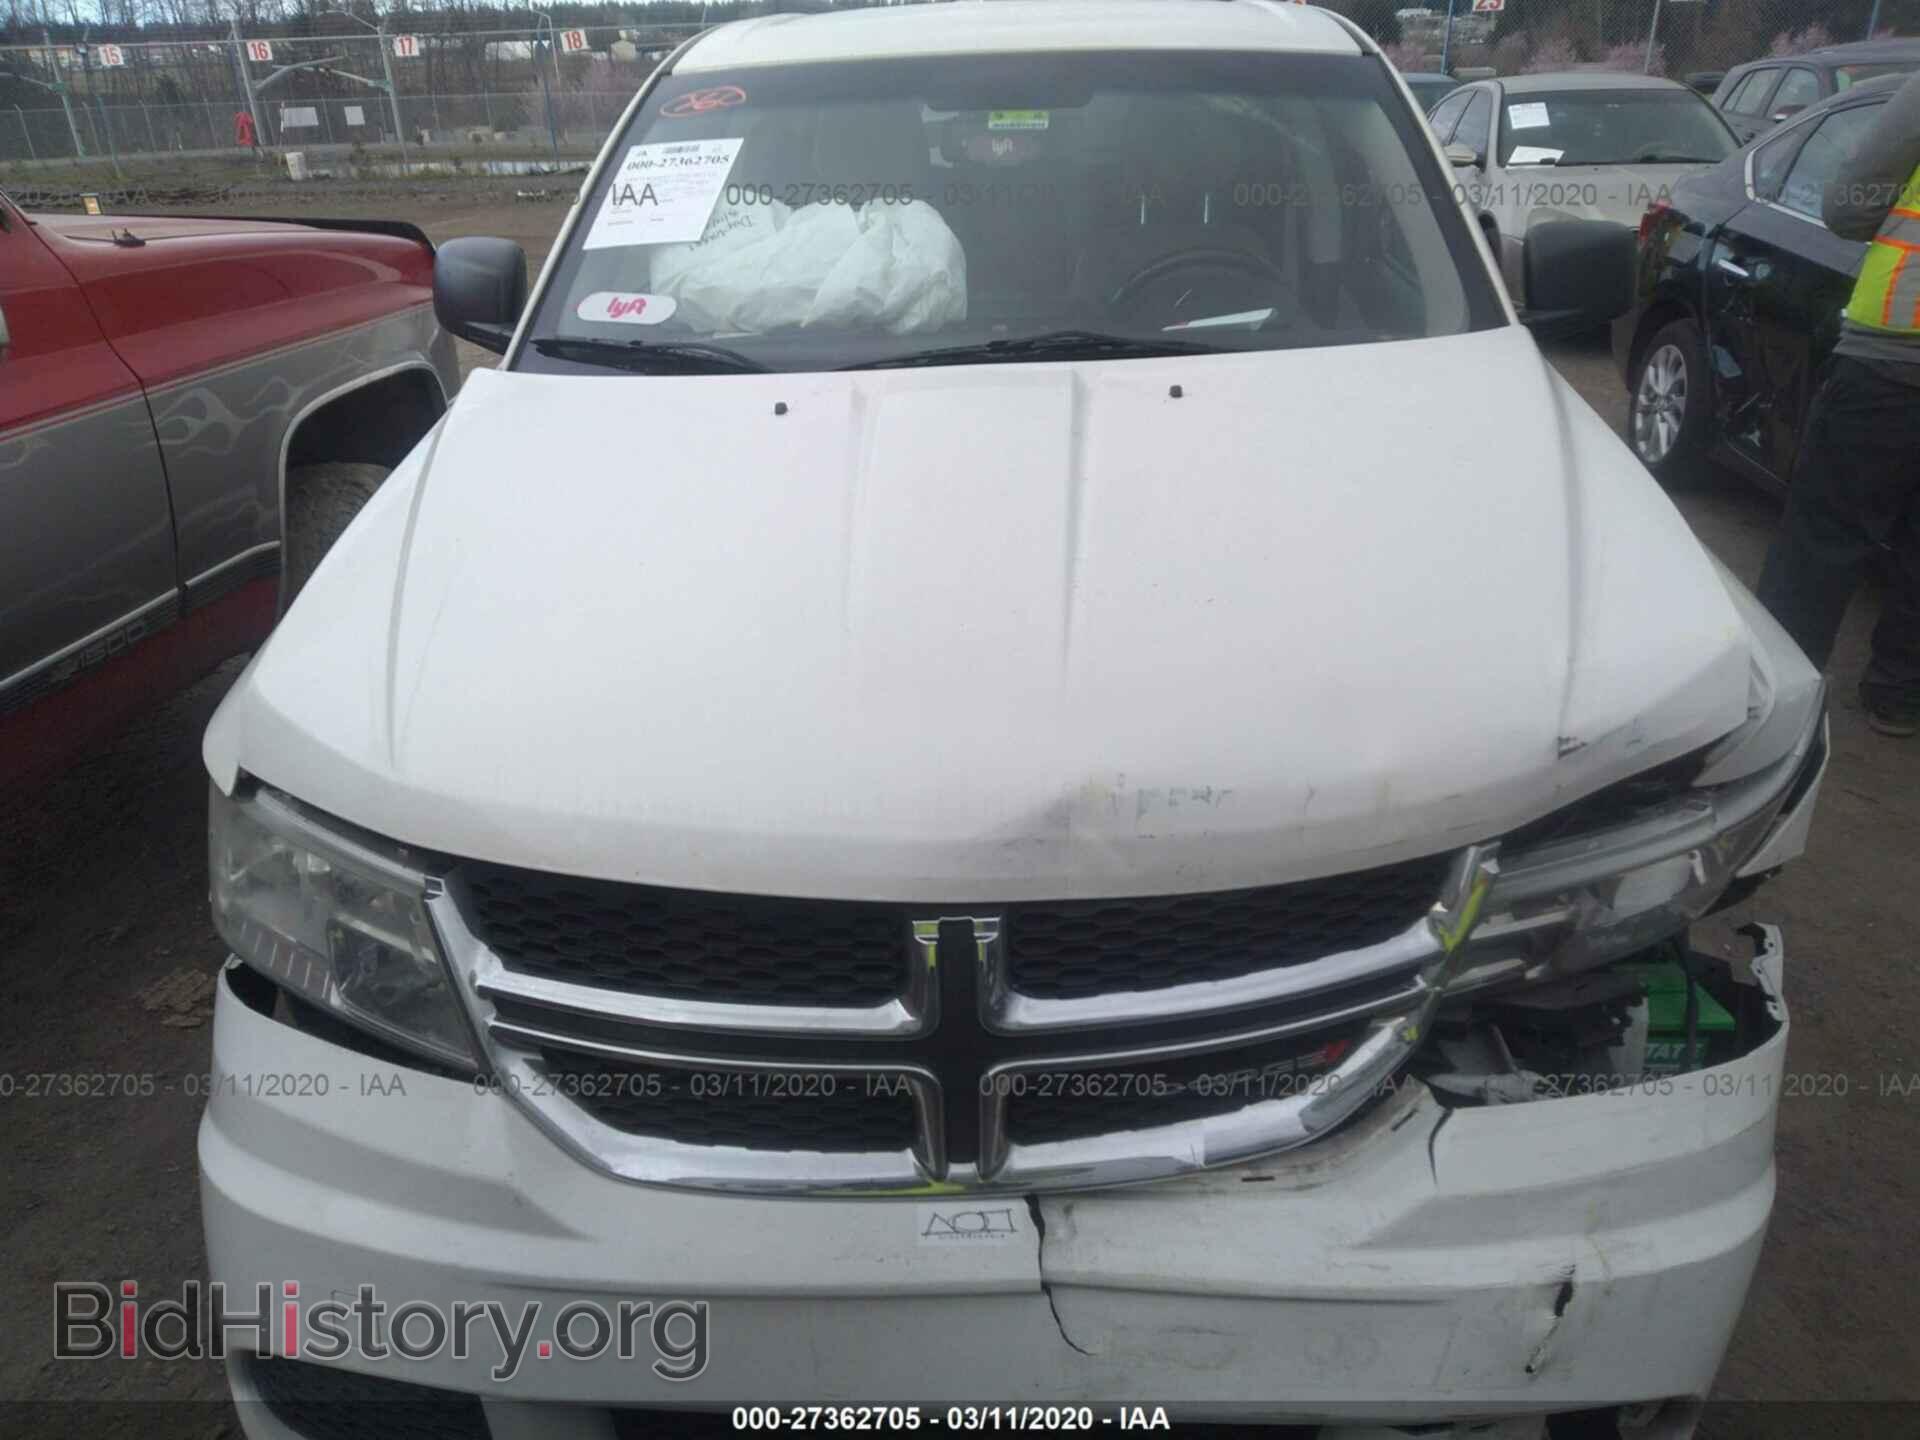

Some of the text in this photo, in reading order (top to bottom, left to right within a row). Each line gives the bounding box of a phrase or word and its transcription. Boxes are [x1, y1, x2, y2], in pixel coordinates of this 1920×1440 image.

[400, 37, 413, 56] 17
[565, 31, 582, 50] 18
[103, 48, 121, 66] 15
[251, 41, 269, 60] 16
